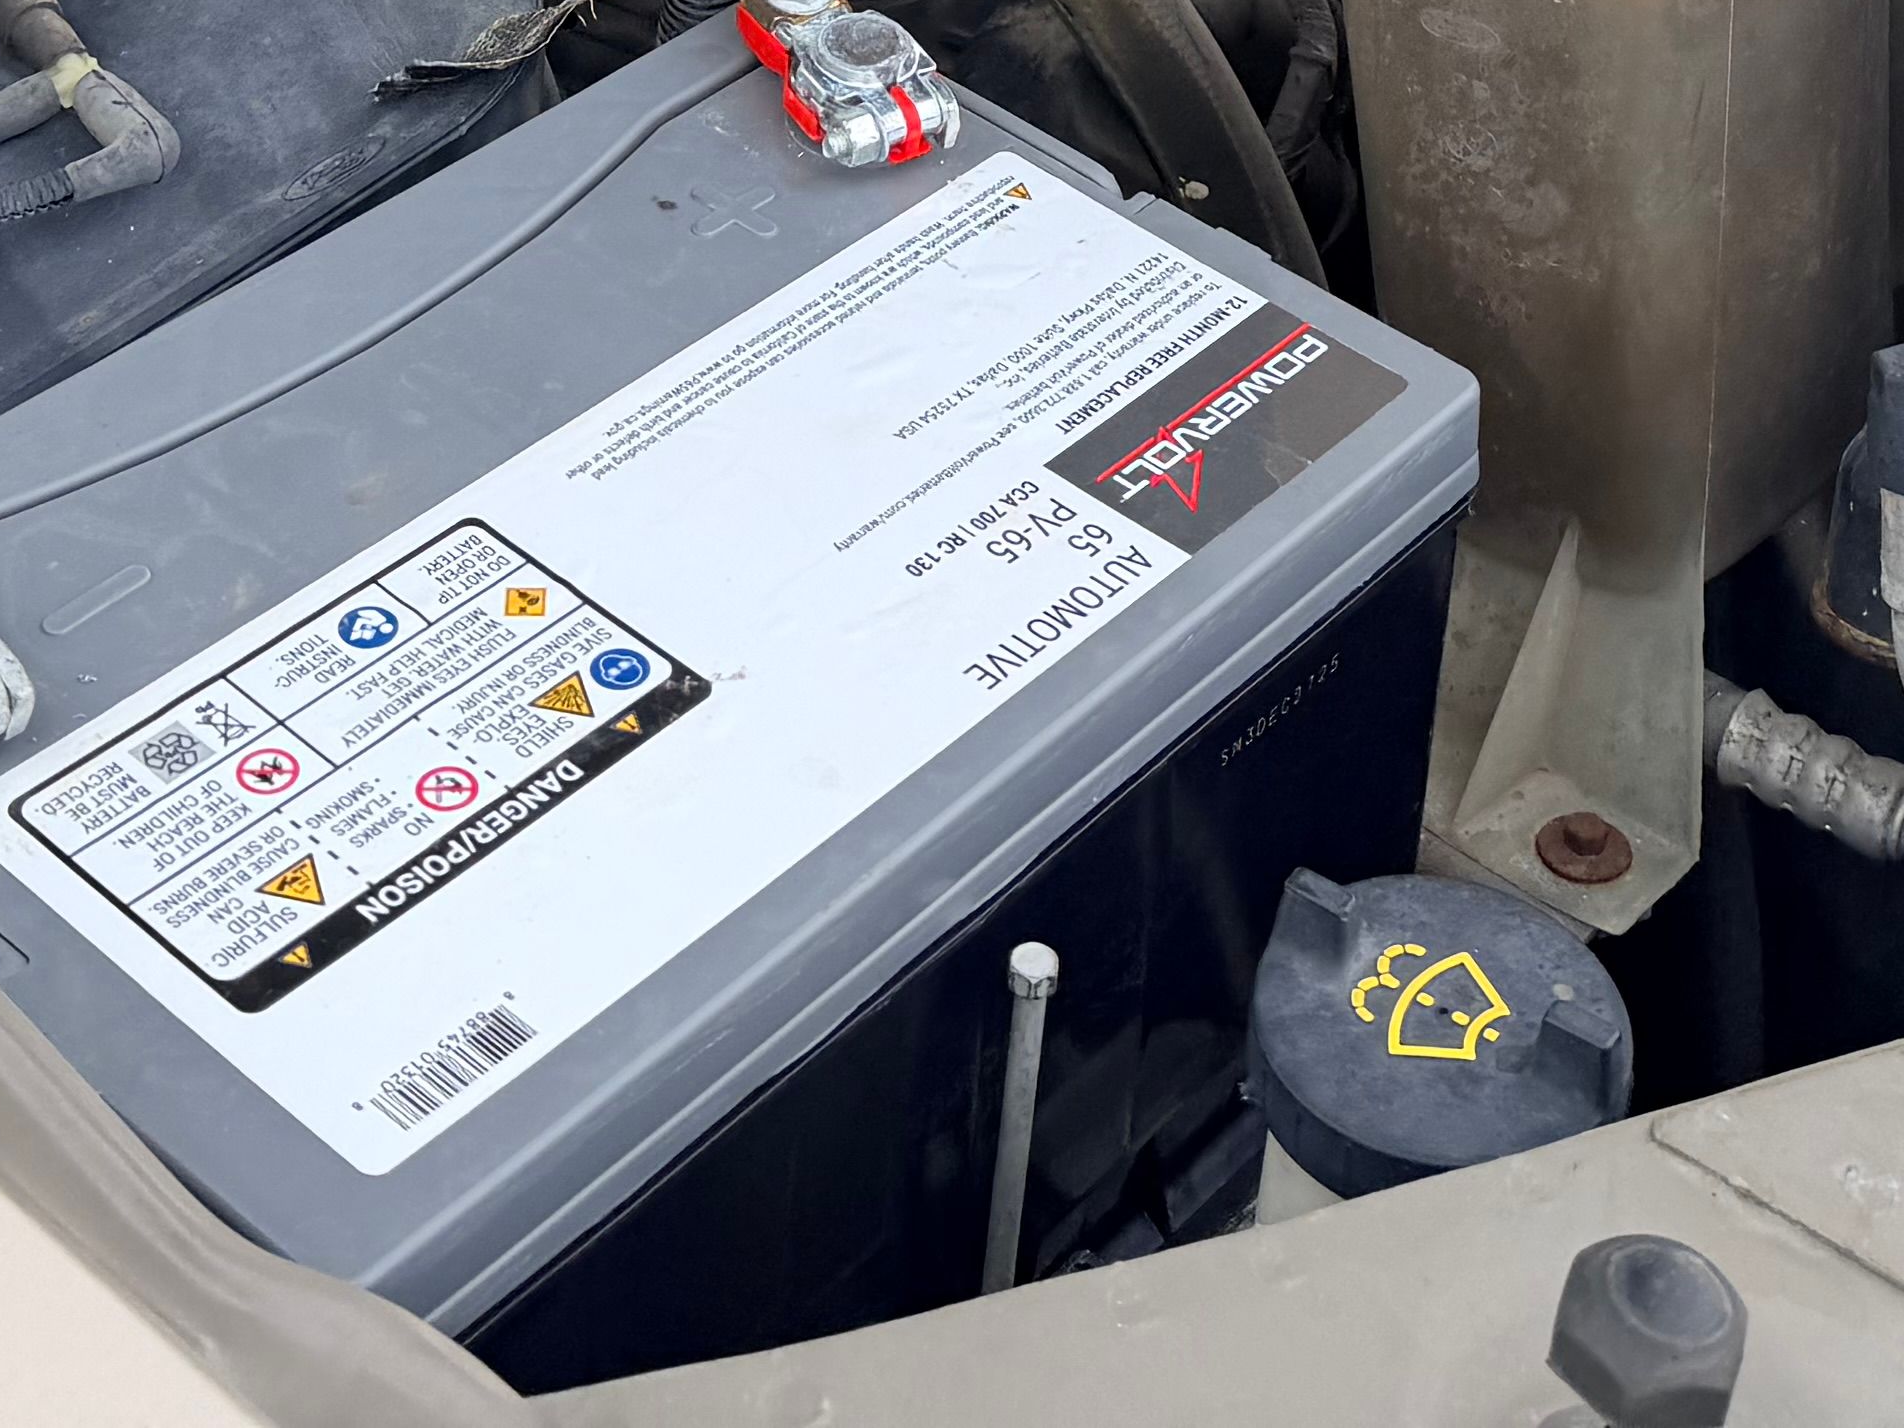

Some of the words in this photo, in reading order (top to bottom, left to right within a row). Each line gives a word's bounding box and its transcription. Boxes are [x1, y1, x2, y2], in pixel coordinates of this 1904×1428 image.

[1178, 296, 1247, 345] 12-MONTH
[1145, 342, 1184, 368] FREE
[952, 387, 975, 401] TX
[1056, 365, 1152, 433] REPLACEMENT
[893, 421, 923, 439] USA
[1116, 336, 1326, 497] POWERVOLT
[999, 481, 1039, 506] CCA
[970, 505, 1007, 530] 700
[987, 499, 1076, 563] PV-65
[419, 535, 482, 575] BATTERY.
[472, 545, 496, 561] OR
[936, 533, 966, 554] RC
[1068, 524, 1112, 557] 65
[435, 559, 476, 585] OPEN
[459, 569, 490, 590] NOT
[487, 555, 511, 571] DO
[906, 552, 941, 576] 130
[438, 587, 462, 604] TIP
[423, 608, 487, 649] MEDICAL
[461, 619, 502, 646] WITH
[965, 546, 1150, 688] AUTOMOTIVE
[276, 635, 328, 665] TIONS.
[468, 628, 516, 662] FLUSH
[523, 617, 596, 667] BLINDNESS
[573, 628, 612, 655] SIVE
[275, 644, 342, 687] INSTRUC-
[314, 655, 356, 683] READ
[389, 648, 426, 676] HELP
[409, 644, 465, 677] WATER.
[433, 658, 472, 683] EYES
[500, 663, 527, 682] OR
[523, 652, 577, 688] GASES
[346, 672, 388, 700] FAST.
[382, 677, 412, 698] GET
[453, 678, 506, 714] INJURY.
[492, 685, 525, 709] CAN
[193, 700, 216, 716] Pb
[342, 681, 436, 747] IMMEDIATELY
[447, 706, 495, 739] CAUSE
[474, 704, 530, 742] EXPLO-
[515, 717, 574, 758] SHIELD
[36, 762, 123, 815] RECYCLED.
[91, 774, 137, 807] MUST
[199, 780, 222, 799] OF
[201, 793, 238, 817] THE
[65, 801, 93, 822] BE
[82, 786, 151, 834] BATTERY
[114, 795, 198, 848] CHILDREN.
[212, 803, 252, 833] KEEP
[306, 782, 374, 829] SMOKING
[331, 794, 391, 836] FLAMES
[147, 813, 204, 852] REACH
[259, 826, 285, 844] OR
[350, 807, 407, 848] SPARKS
[404, 812, 434, 836] NO
[175, 830, 210, 856] OUT
[248, 838, 299, 874] CAUSE
[355, 761, 584, 923] DANGER/POISON
[152, 852, 176, 872] OF
[204, 841, 262, 881] SEVERE
[149, 877, 207, 914] BURNS.
[167, 870, 251, 928] BLINDNESS
[207, 898, 244, 924] CAN
[228, 901, 270, 934] ACID
[212, 907, 297, 967] SULFURIC
